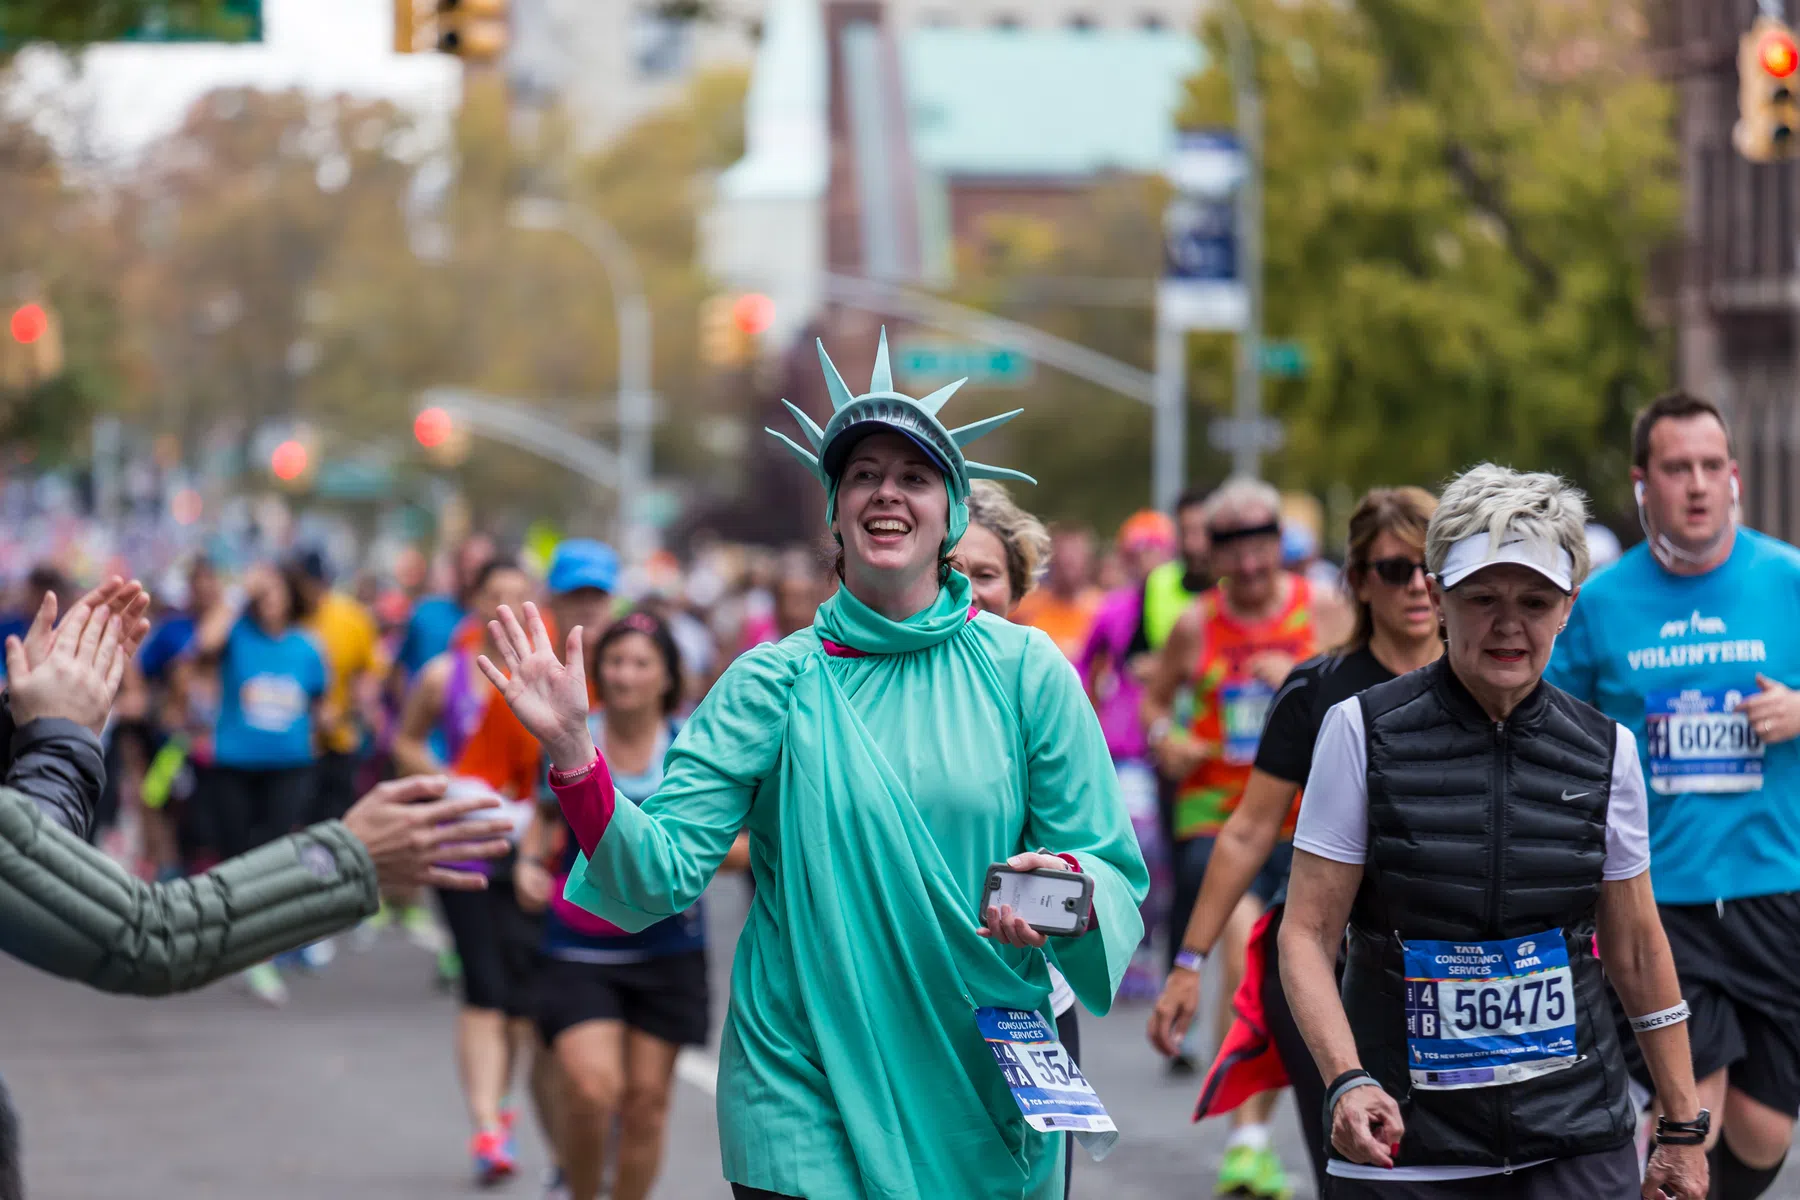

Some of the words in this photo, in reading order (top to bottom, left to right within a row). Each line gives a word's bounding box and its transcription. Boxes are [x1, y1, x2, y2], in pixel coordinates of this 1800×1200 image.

[1627, 639, 1767, 671] VOLUNTEER
[1454, 946, 1484, 955] TATA
[1435, 954, 1503, 965] CONSULTANCY
[1514, 956, 1542, 969] TATA
[1448, 965, 1492, 975] SERVICES
[1421, 984, 1434, 1006] 4
[1455, 976, 1565, 1032] 56475
[1008, 1011, 1030, 1020] TATA
[1422, 1013, 1435, 1036] B
[1010, 1030, 1044, 1039] SERVICES
[1003, 1044, 1017, 1062] 4
[1423, 1052, 1439, 1060] TCS
[1474, 1050, 1489, 1058] CITY
[1489, 1047, 1525, 1056] MARATHON
[1015, 1066, 1032, 1086] A
